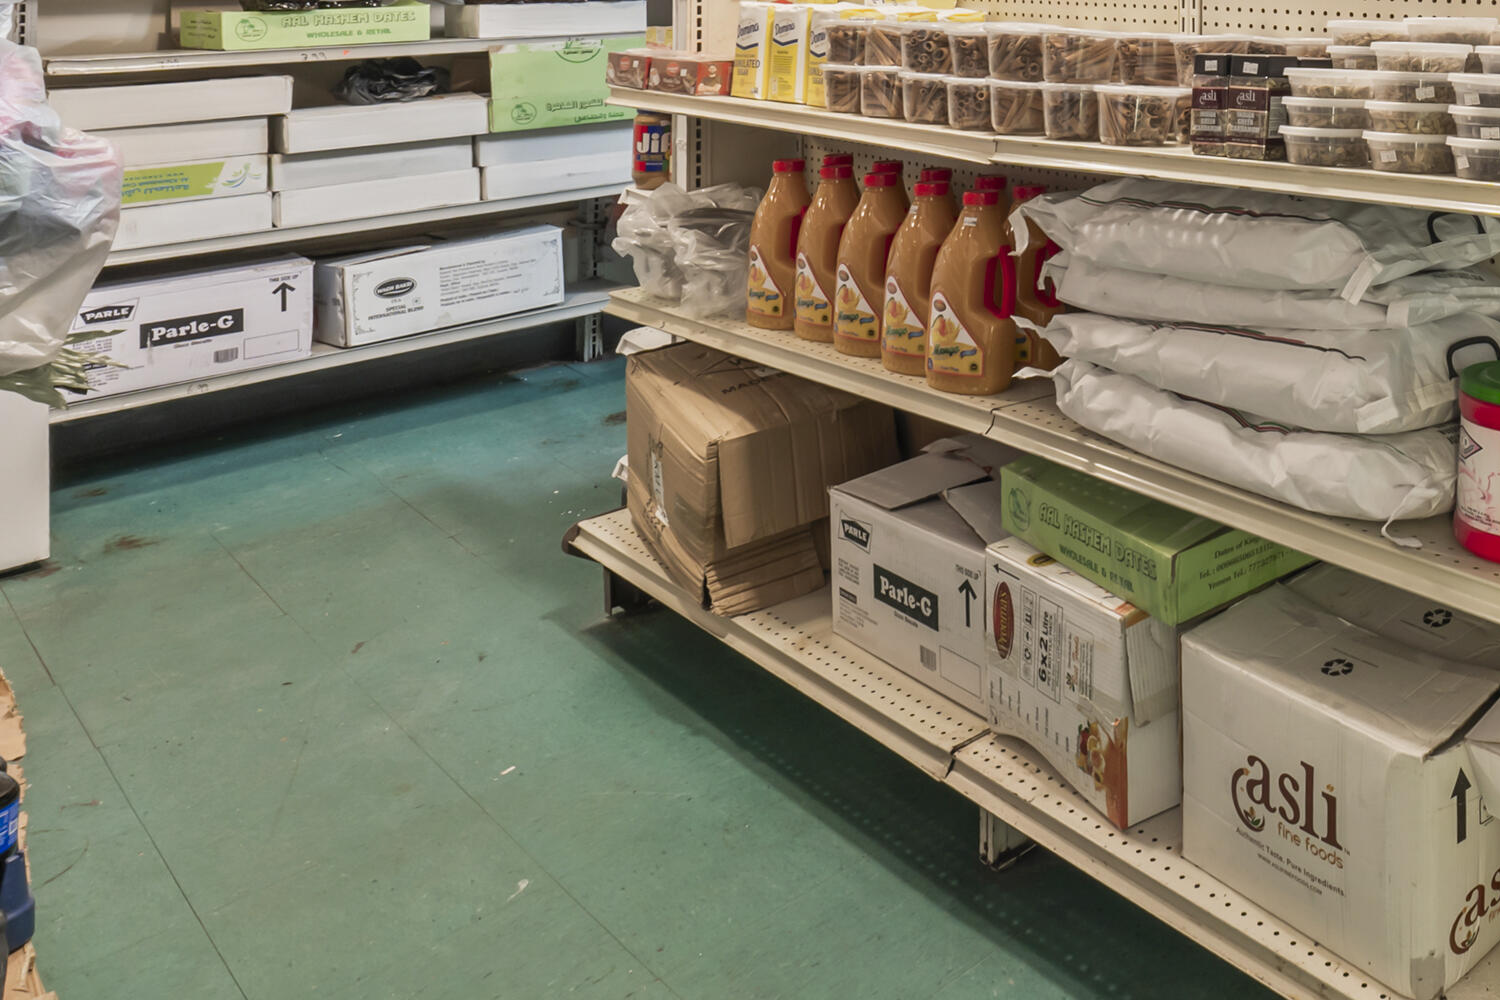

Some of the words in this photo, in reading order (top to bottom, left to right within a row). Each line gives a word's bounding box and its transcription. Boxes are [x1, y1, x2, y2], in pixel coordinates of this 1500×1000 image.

[85, 307, 130, 320] PARLE
[151, 315, 235, 341] Parle-G
[843, 522, 868, 542] PARLE
[1115, 541, 1157, 581] DATES
[879, 575, 932, 617] Parle-G
[1232, 755, 1343, 851] asli
[1277, 822, 1301, 846] fine
[1305, 837, 1344, 869] foods
[1286, 858, 1302, 873] Pure
